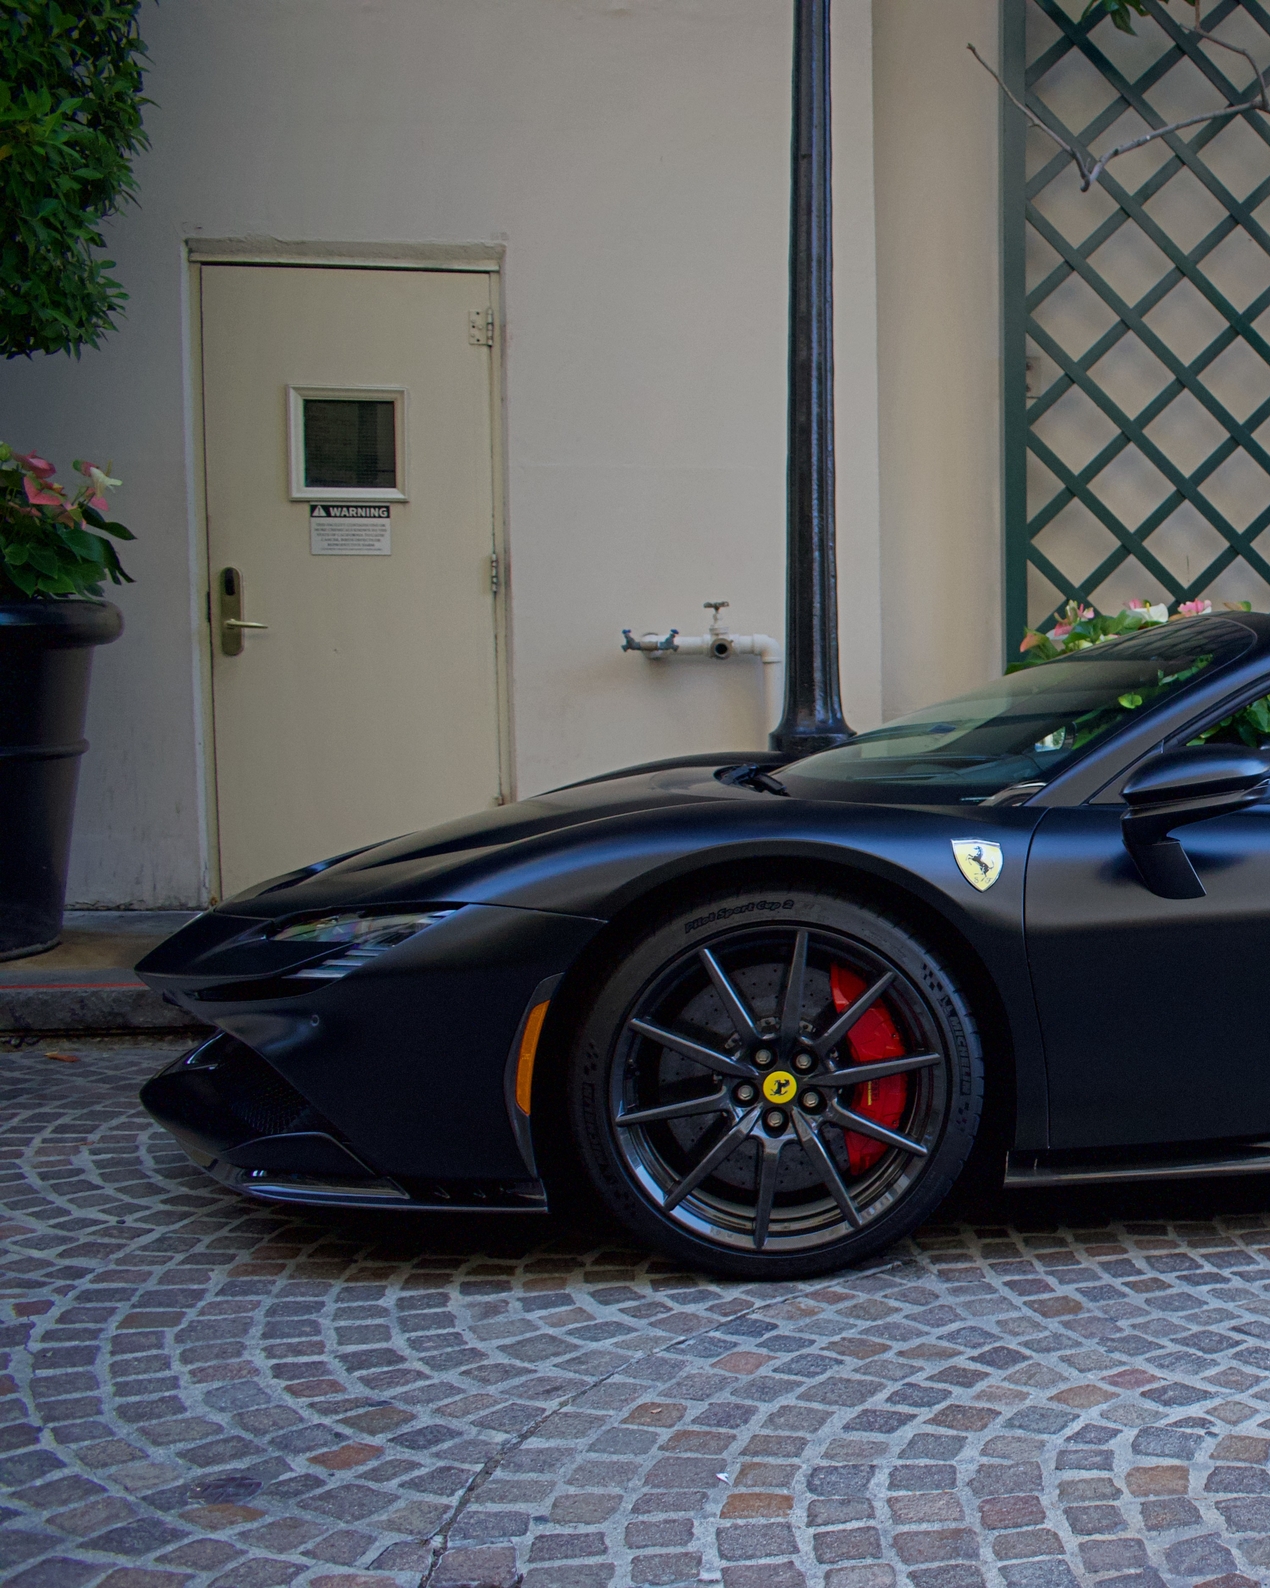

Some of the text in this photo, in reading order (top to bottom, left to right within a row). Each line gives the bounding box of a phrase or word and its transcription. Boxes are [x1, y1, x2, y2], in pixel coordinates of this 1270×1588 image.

[329, 507, 388, 517] WARNING
[685, 899, 795, 934] Pilot Sport Cup 2
[947, 1016, 972, 1096] MICHELIN
